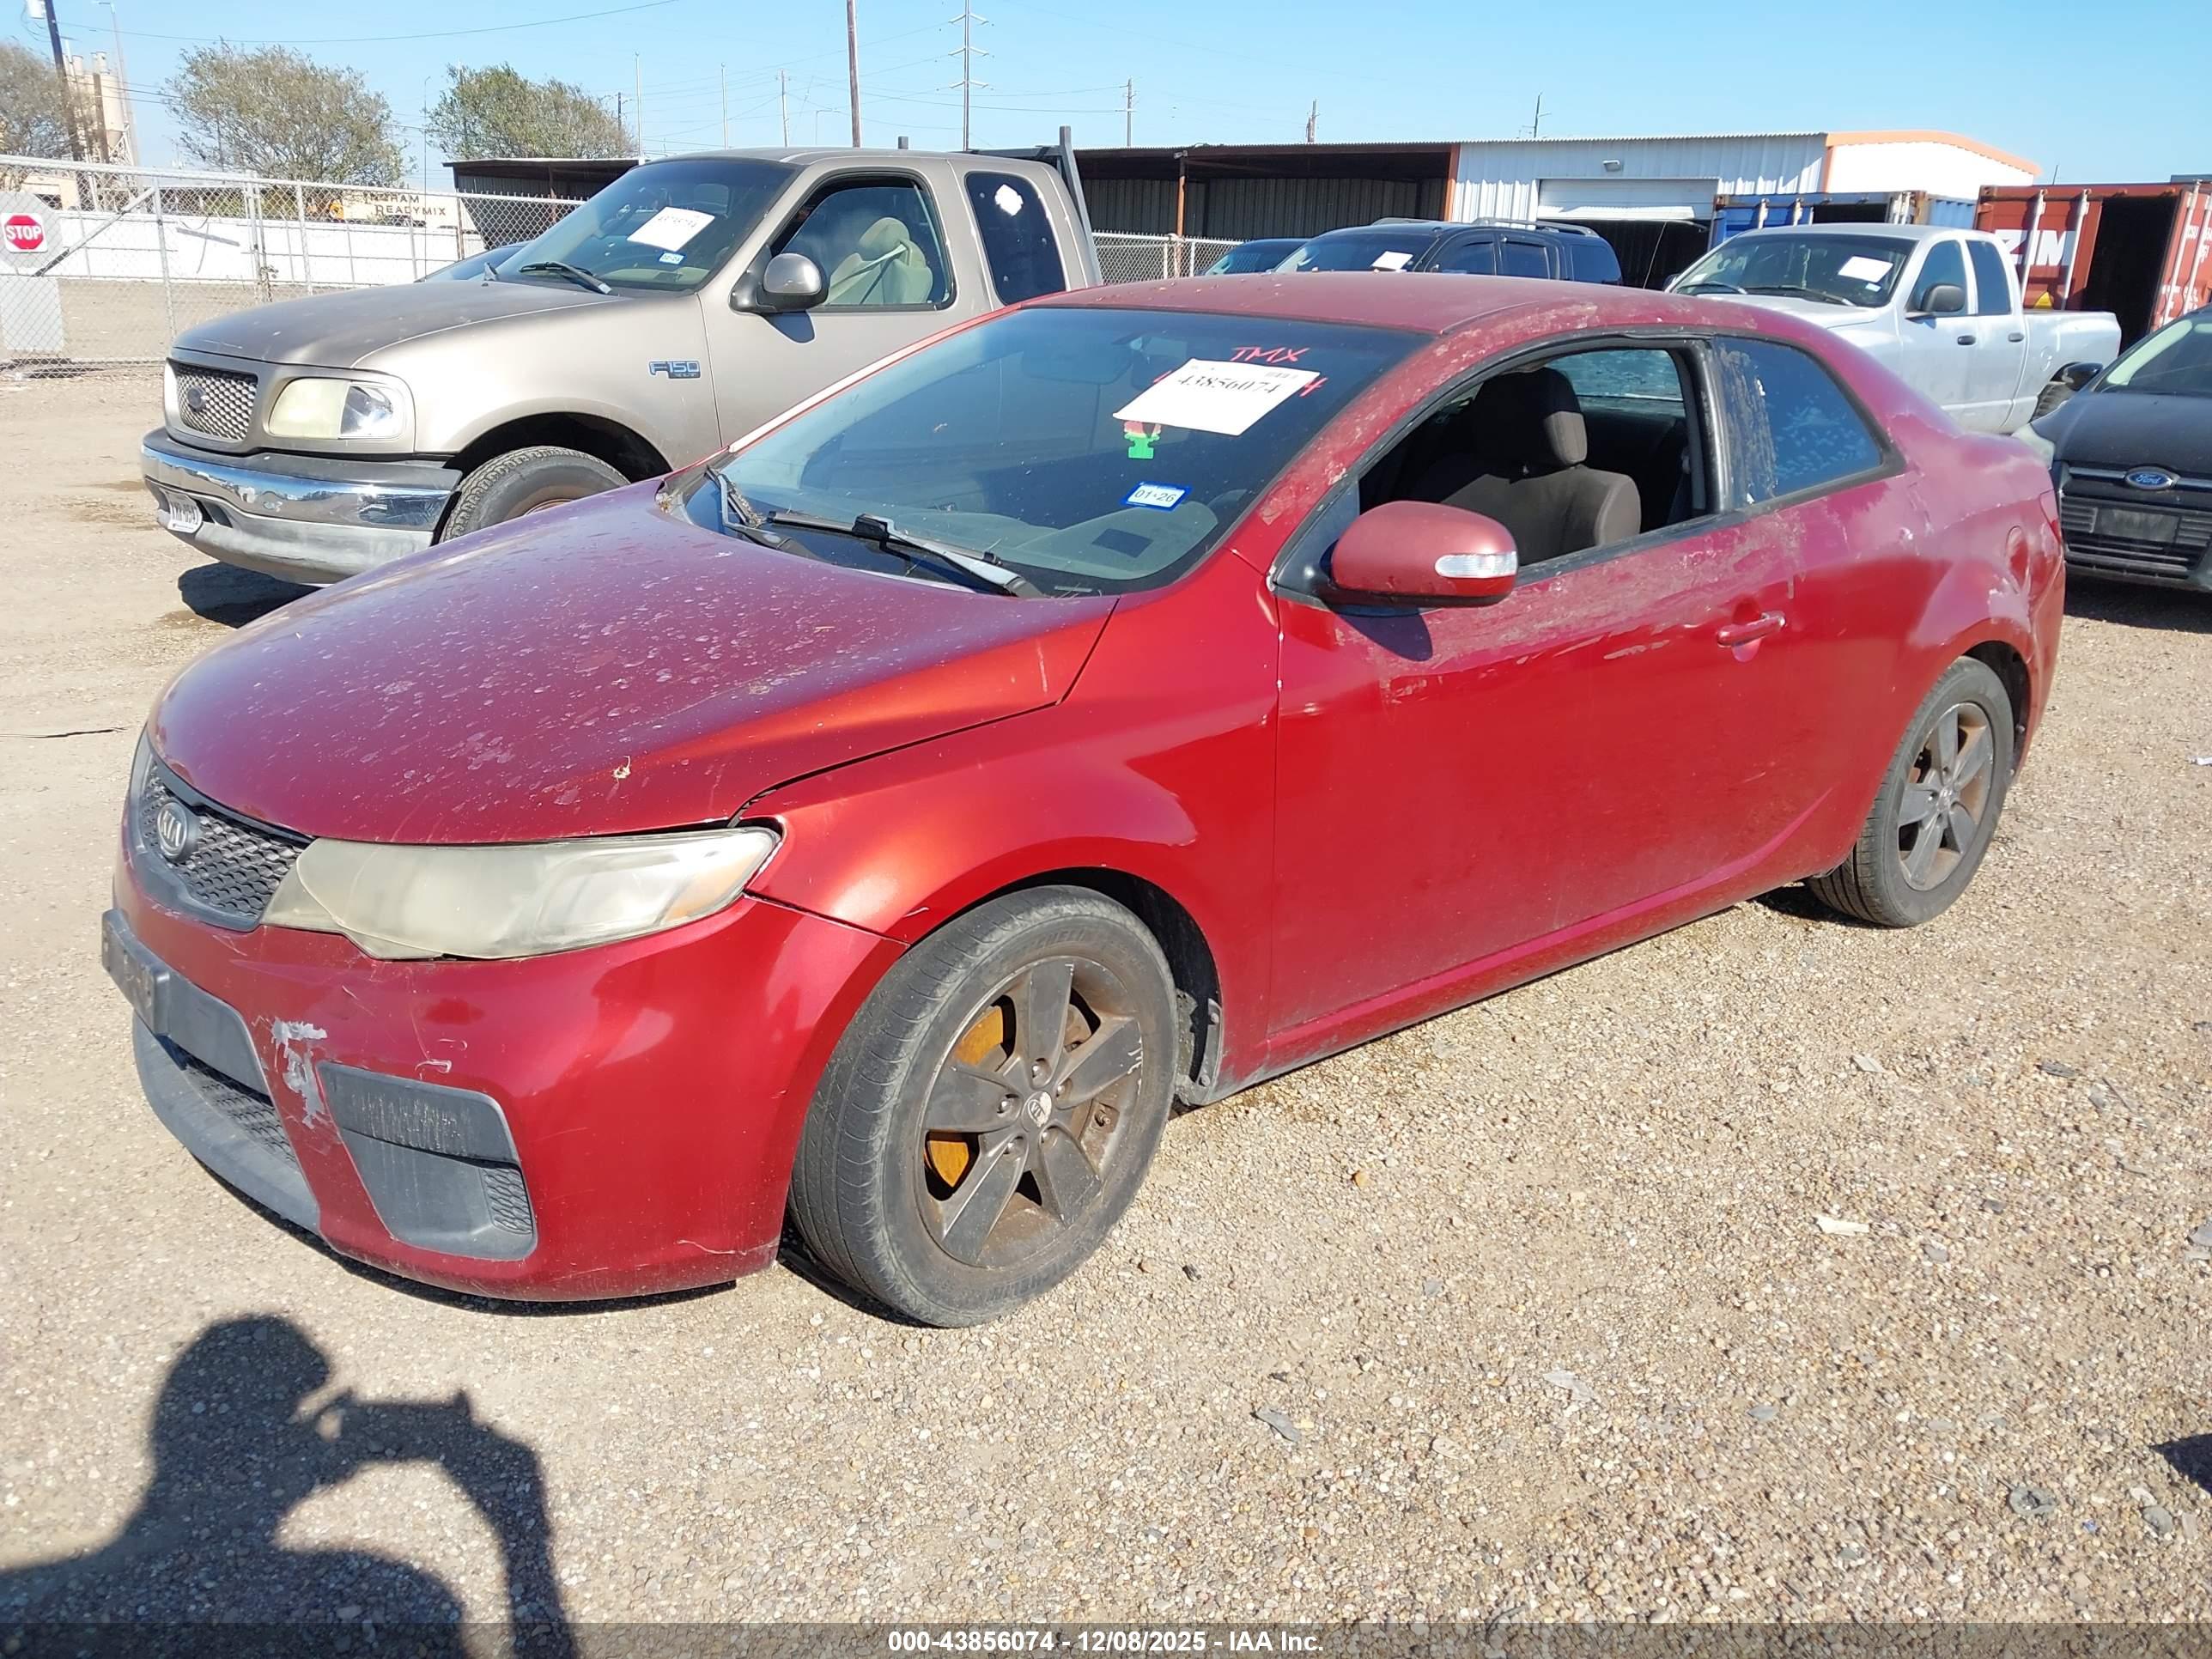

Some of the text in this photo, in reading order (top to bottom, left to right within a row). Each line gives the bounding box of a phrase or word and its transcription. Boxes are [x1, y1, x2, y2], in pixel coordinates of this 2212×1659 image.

[374, 204, 447, 216] READYMIX
[6, 224, 42, 240] STOP
[1994, 228, 2076, 266] ZIM
[1229, 346, 1310, 364] TMX
[1177, 374, 1283, 394] 43856074
[2135, 472, 2160, 484] Ford
